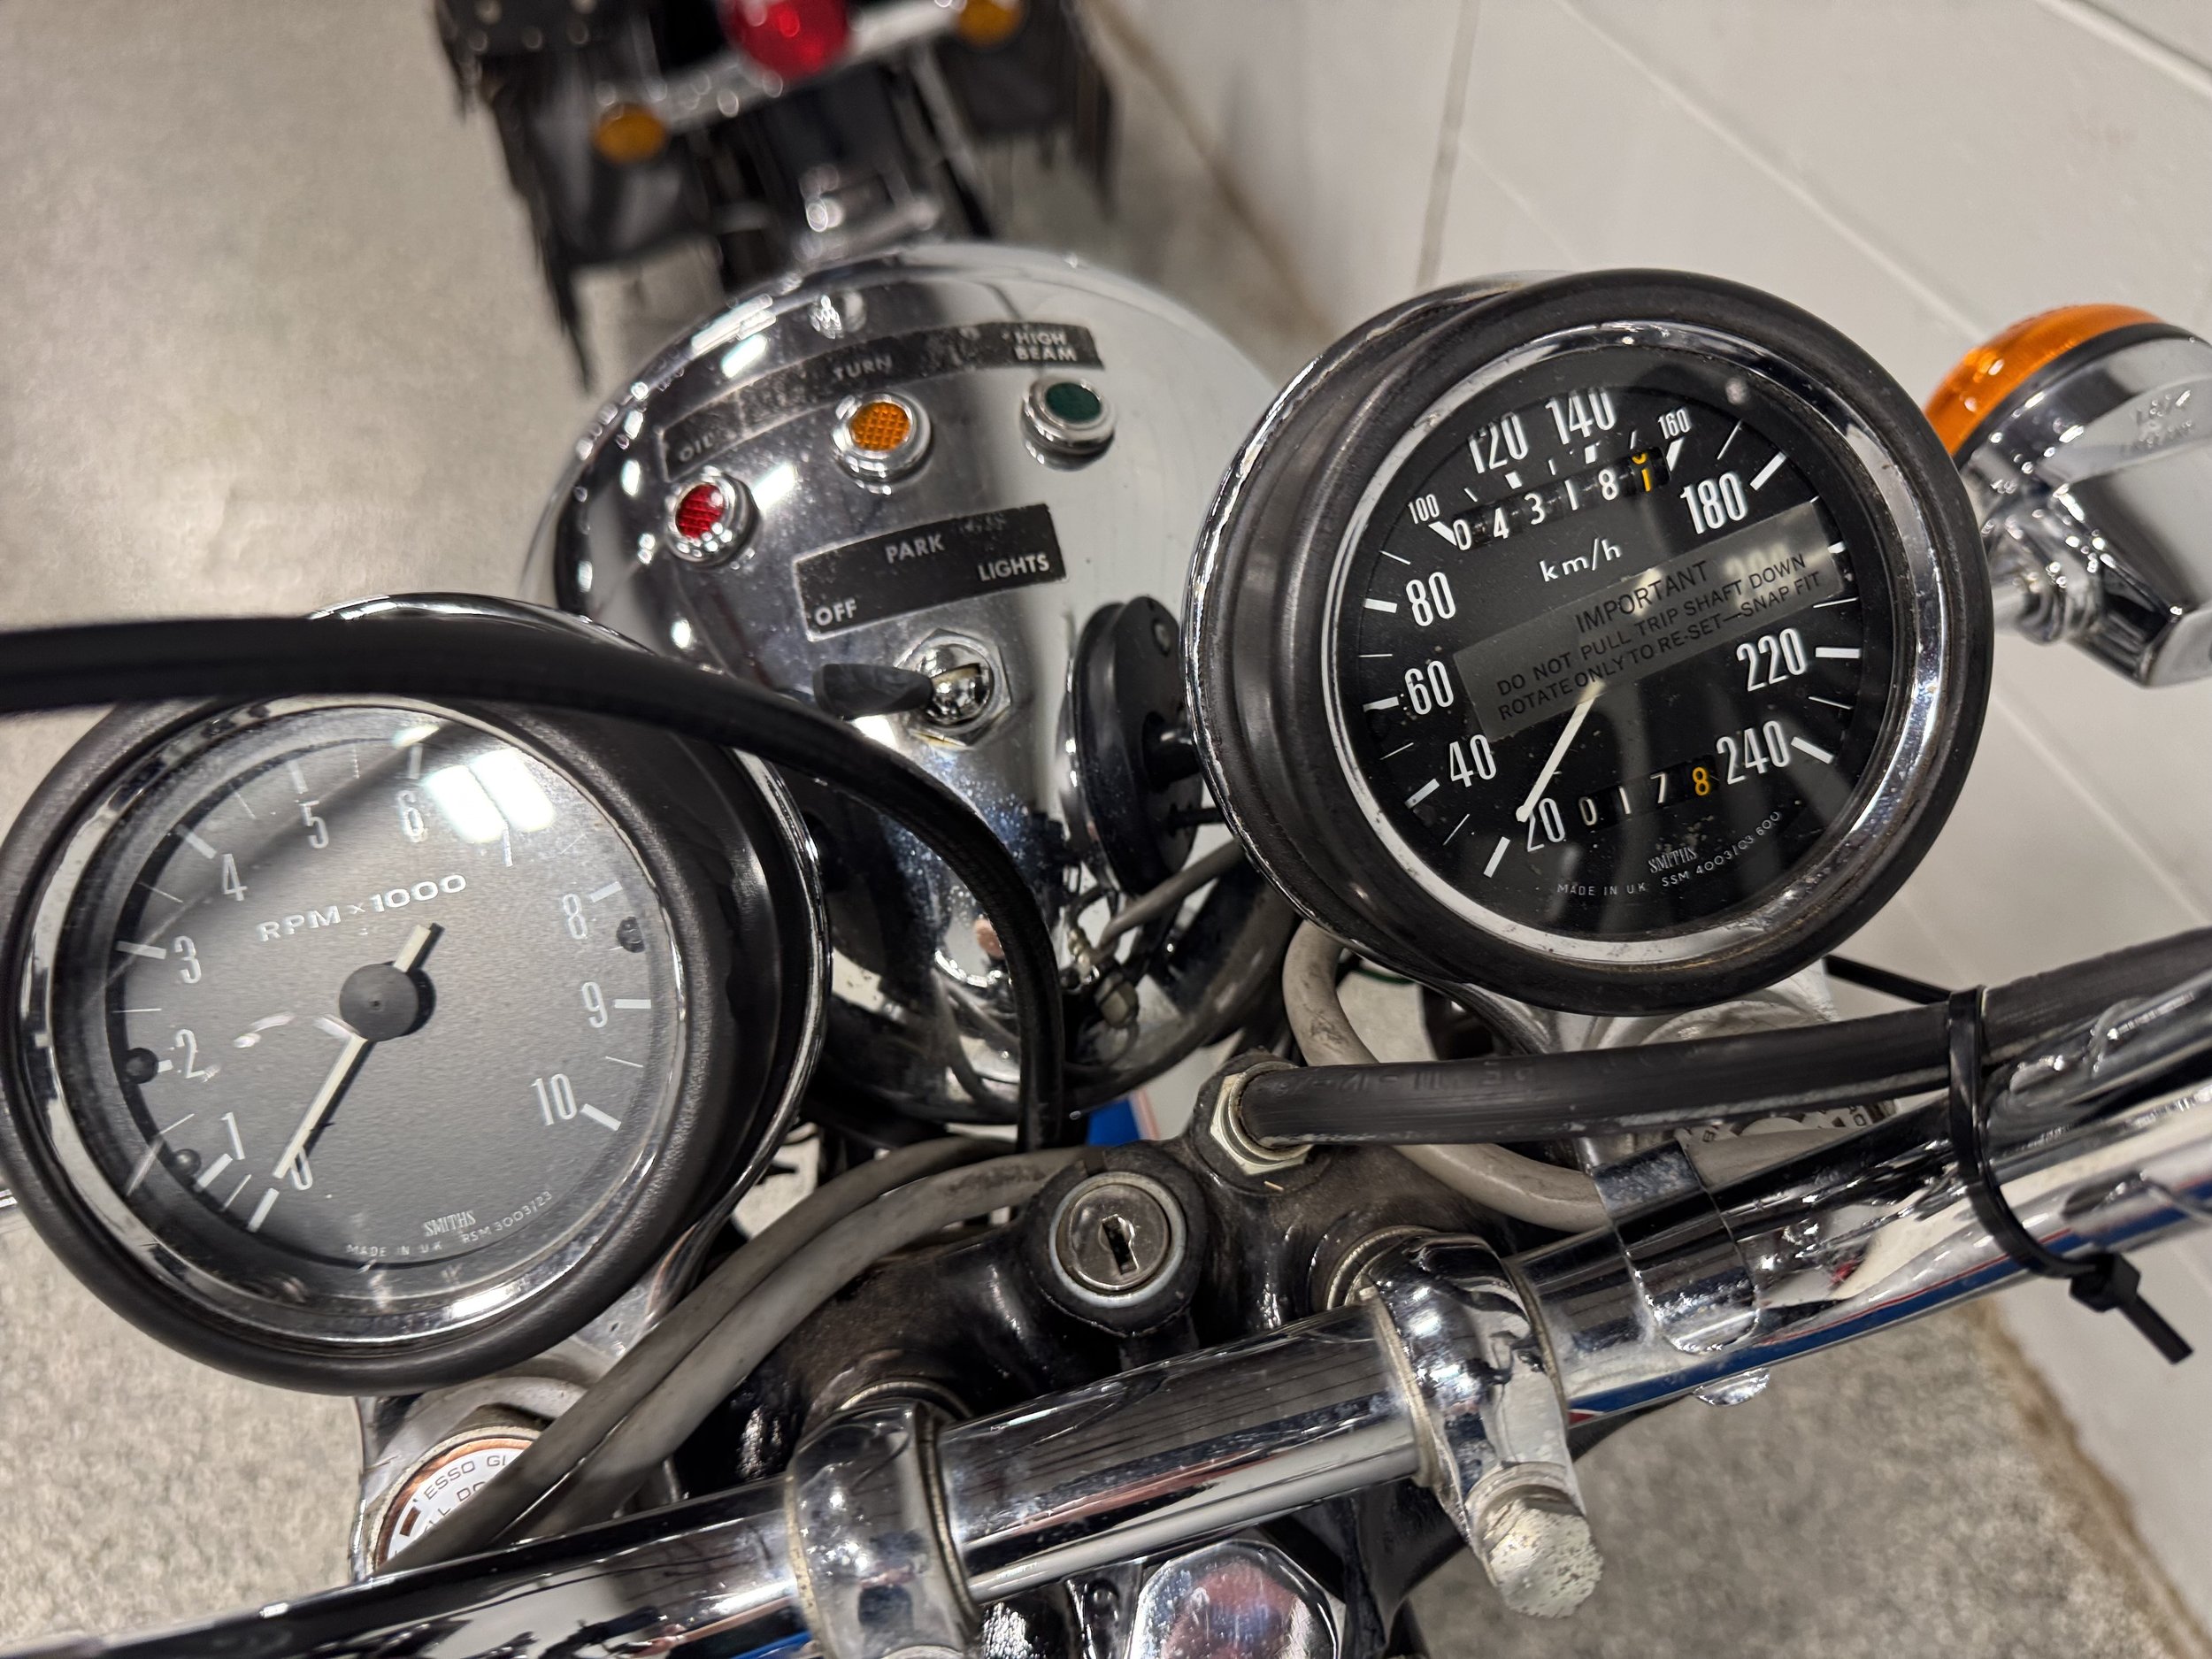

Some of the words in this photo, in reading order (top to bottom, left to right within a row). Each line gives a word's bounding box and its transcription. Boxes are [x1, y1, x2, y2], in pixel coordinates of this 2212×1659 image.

[1014, 330, 1067, 346] HIGH
[1014, 347, 1077, 362] BEAM
[833, 355, 893, 381] TURN
[1546, 387, 1617, 445] 140
[1657, 406, 1693, 439] 160
[1468, 411, 1529, 474] 120
[1408, 493, 1440, 525] 100
[1680, 471, 1747, 534] 180
[885, 534, 945, 564] PARK
[979, 551, 1050, 582] LIGHTS
[1539, 537, 1622, 582] km/h
[814, 597, 857, 626] OFF
[1405, 571, 1455, 627] 80
[1576, 559, 1708, 634] IMPORTANT
[1496, 672, 1525, 696] DO
[1533, 651, 1572, 681] NOT
[1580, 630, 1632, 661] PULL
[1635, 609, 1678, 637] TRIP
[1683, 579, 1743, 618] SHAFT
[1748, 553, 1806, 590] DOWN
[1498, 682, 1573, 720] ROTATE
[1576, 658, 1624, 687] ONLY
[1628, 644, 1655, 666] TO
[1793, 571, 1822, 595] FIT
[1736, 627, 1808, 692] 220
[1403, 660, 1454, 716] 60
[1448, 733, 1497, 787] 40
[1716, 720, 1791, 786] 240
[296, 799, 330, 849] 5
[395, 788, 428, 844] 6
[1527, 798, 1566, 852] 20
[221, 853, 249, 902] 4
[1556, 884, 1595, 896] MADE
[1603, 886, 1617, 895] IN
[1661, 870, 1691, 888] SSM
[1755, 810, 1781, 837] 600
[1647, 846, 1699, 874] SMITHS
[255, 904, 342, 942] RPM
[370, 873, 467, 914] 1000
[563, 893, 588, 940] 8
[174, 935, 203, 985] 3
[581, 980, 608, 1028] 9
[175, 1028, 205, 1079] 2
[529, 1072, 578, 1126] 10
[220, 1111, 246, 1160] 1
[345, 1243, 387, 1257] MADE
[398, 1246, 410, 1256] IN
[461, 1225, 492, 1245] RSM
[423, 1210, 476, 1237] SMITHS
